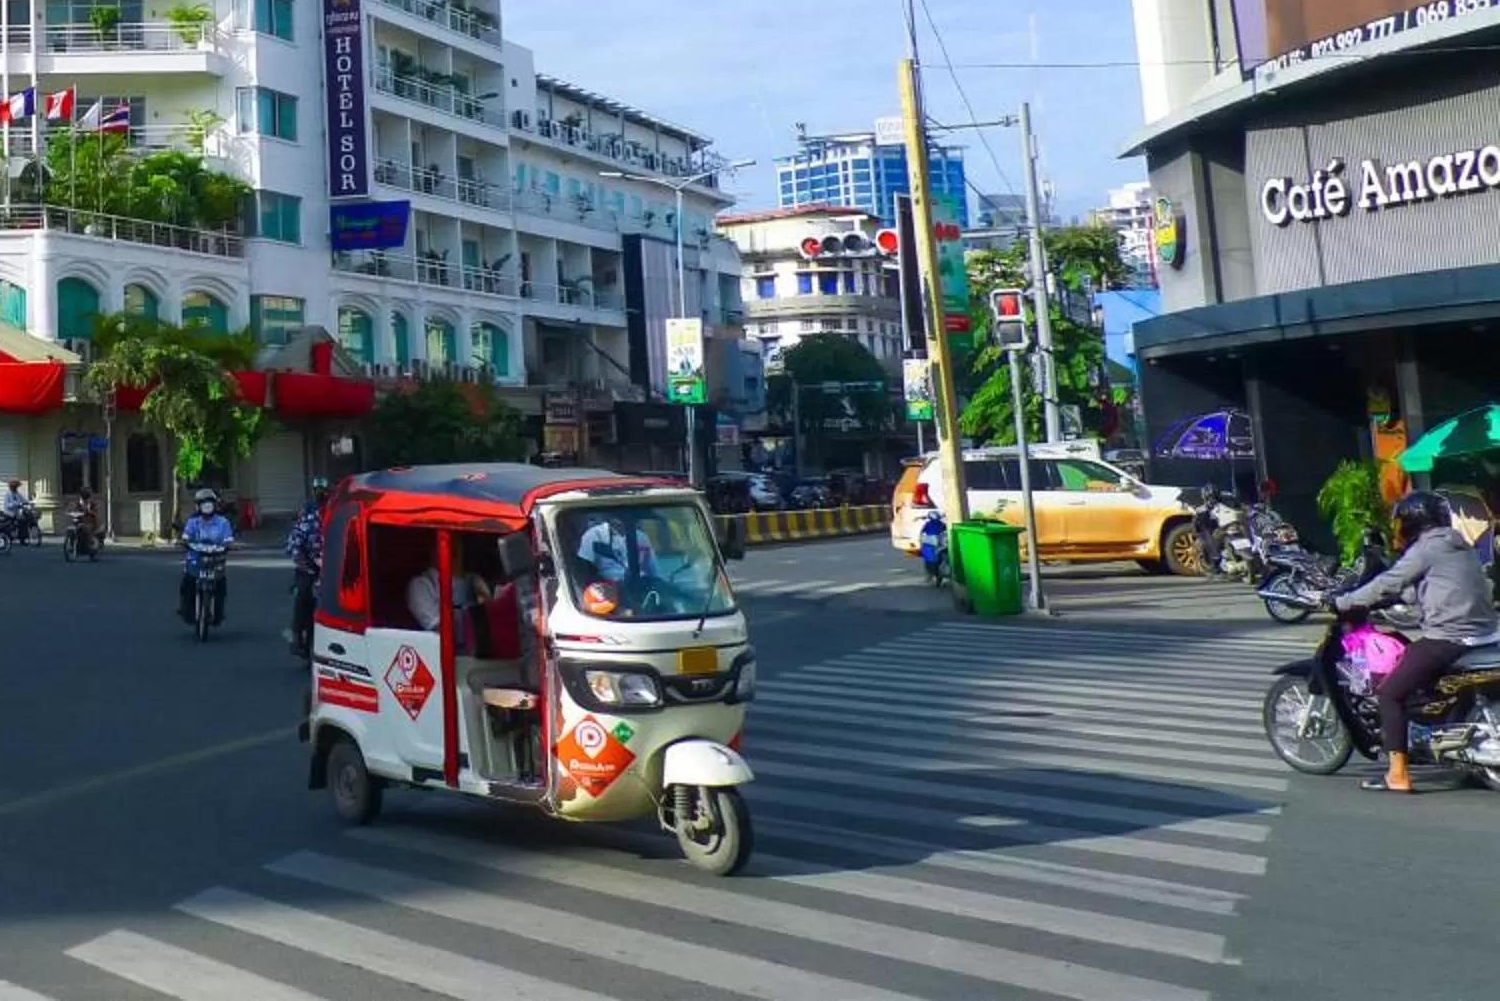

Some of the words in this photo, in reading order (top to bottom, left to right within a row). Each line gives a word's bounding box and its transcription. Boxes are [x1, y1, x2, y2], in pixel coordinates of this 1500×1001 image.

[1365, 15, 1397, 42] 777
[1415, 0, 1449, 28] 069
[336, 36, 354, 128] HOTEL
[339, 134, 357, 191] SOR
[1261, 158, 1347, 225] Café
[1357, 145, 1500, 209] Amazo
